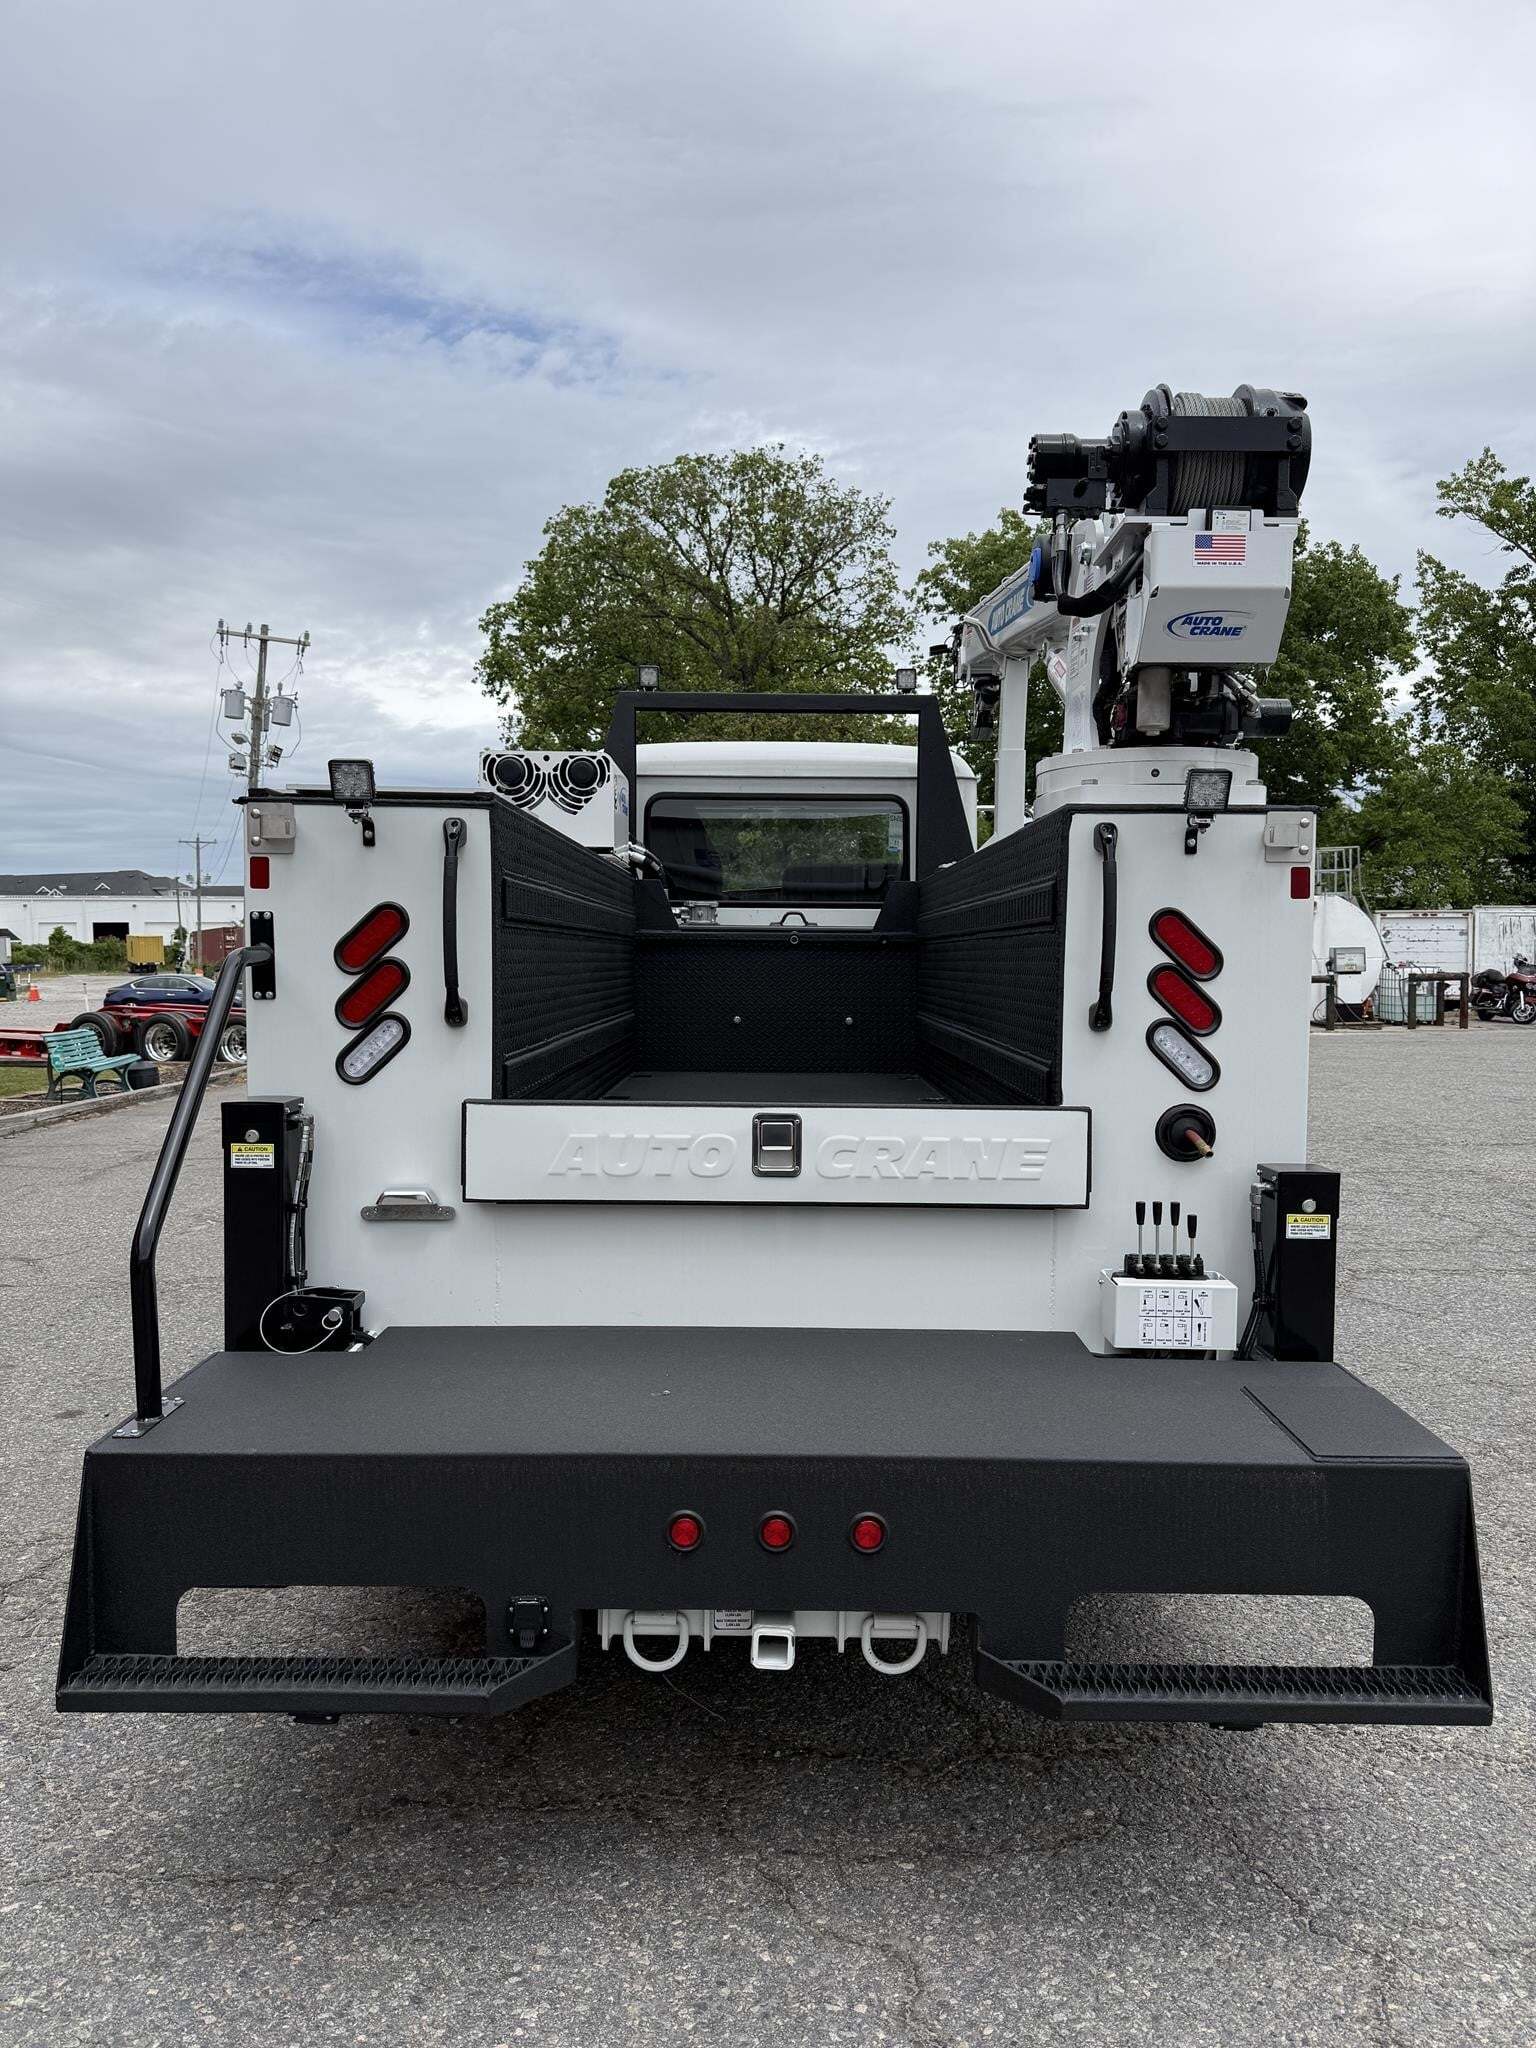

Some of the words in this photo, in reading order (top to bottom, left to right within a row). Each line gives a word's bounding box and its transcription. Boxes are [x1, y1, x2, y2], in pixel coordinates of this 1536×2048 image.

[1180, 616, 1223, 626] AUTO
[1189, 626, 1243, 636] CRANE
[547, 1133, 737, 1178] AUTO
[816, 1135, 1051, 1181] CRANE
